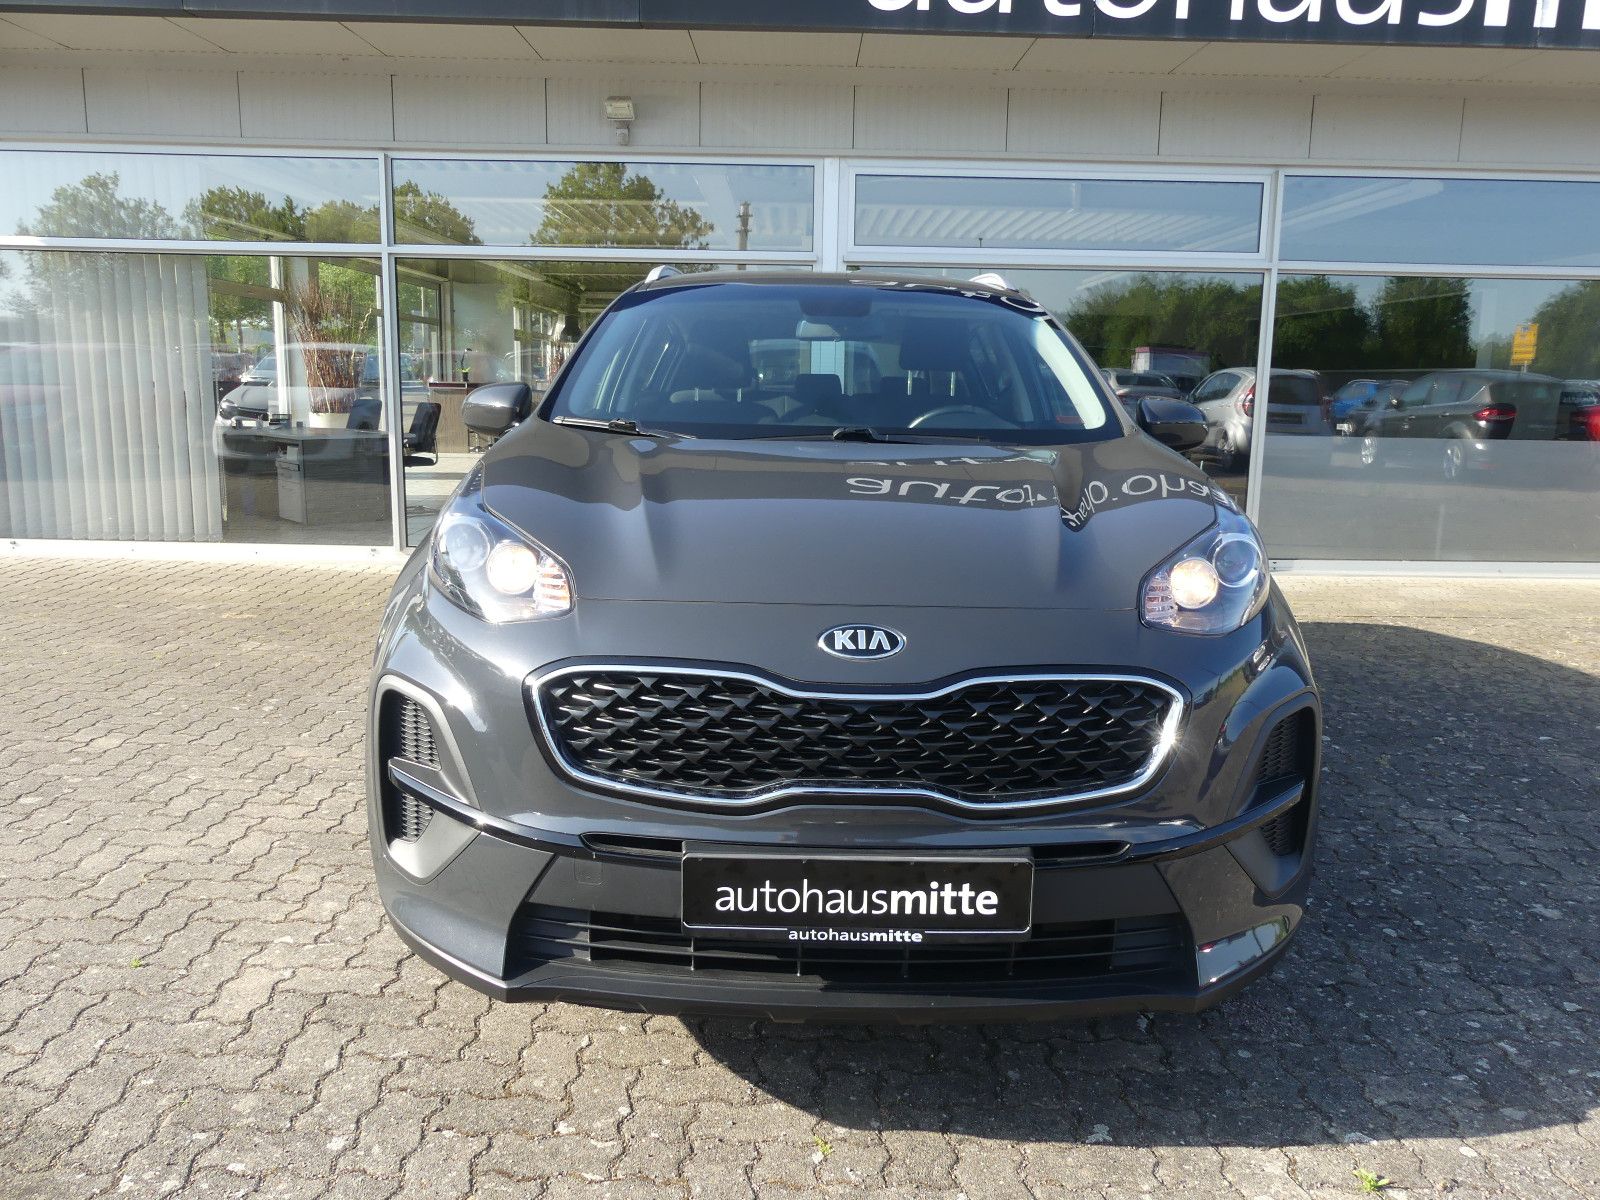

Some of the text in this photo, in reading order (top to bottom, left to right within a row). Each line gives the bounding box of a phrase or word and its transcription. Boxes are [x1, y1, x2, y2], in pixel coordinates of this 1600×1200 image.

[833, 629, 891, 650] KIA
[715, 879, 999, 915] autohausmitte
[788, 927, 923, 942] autohausmitte
